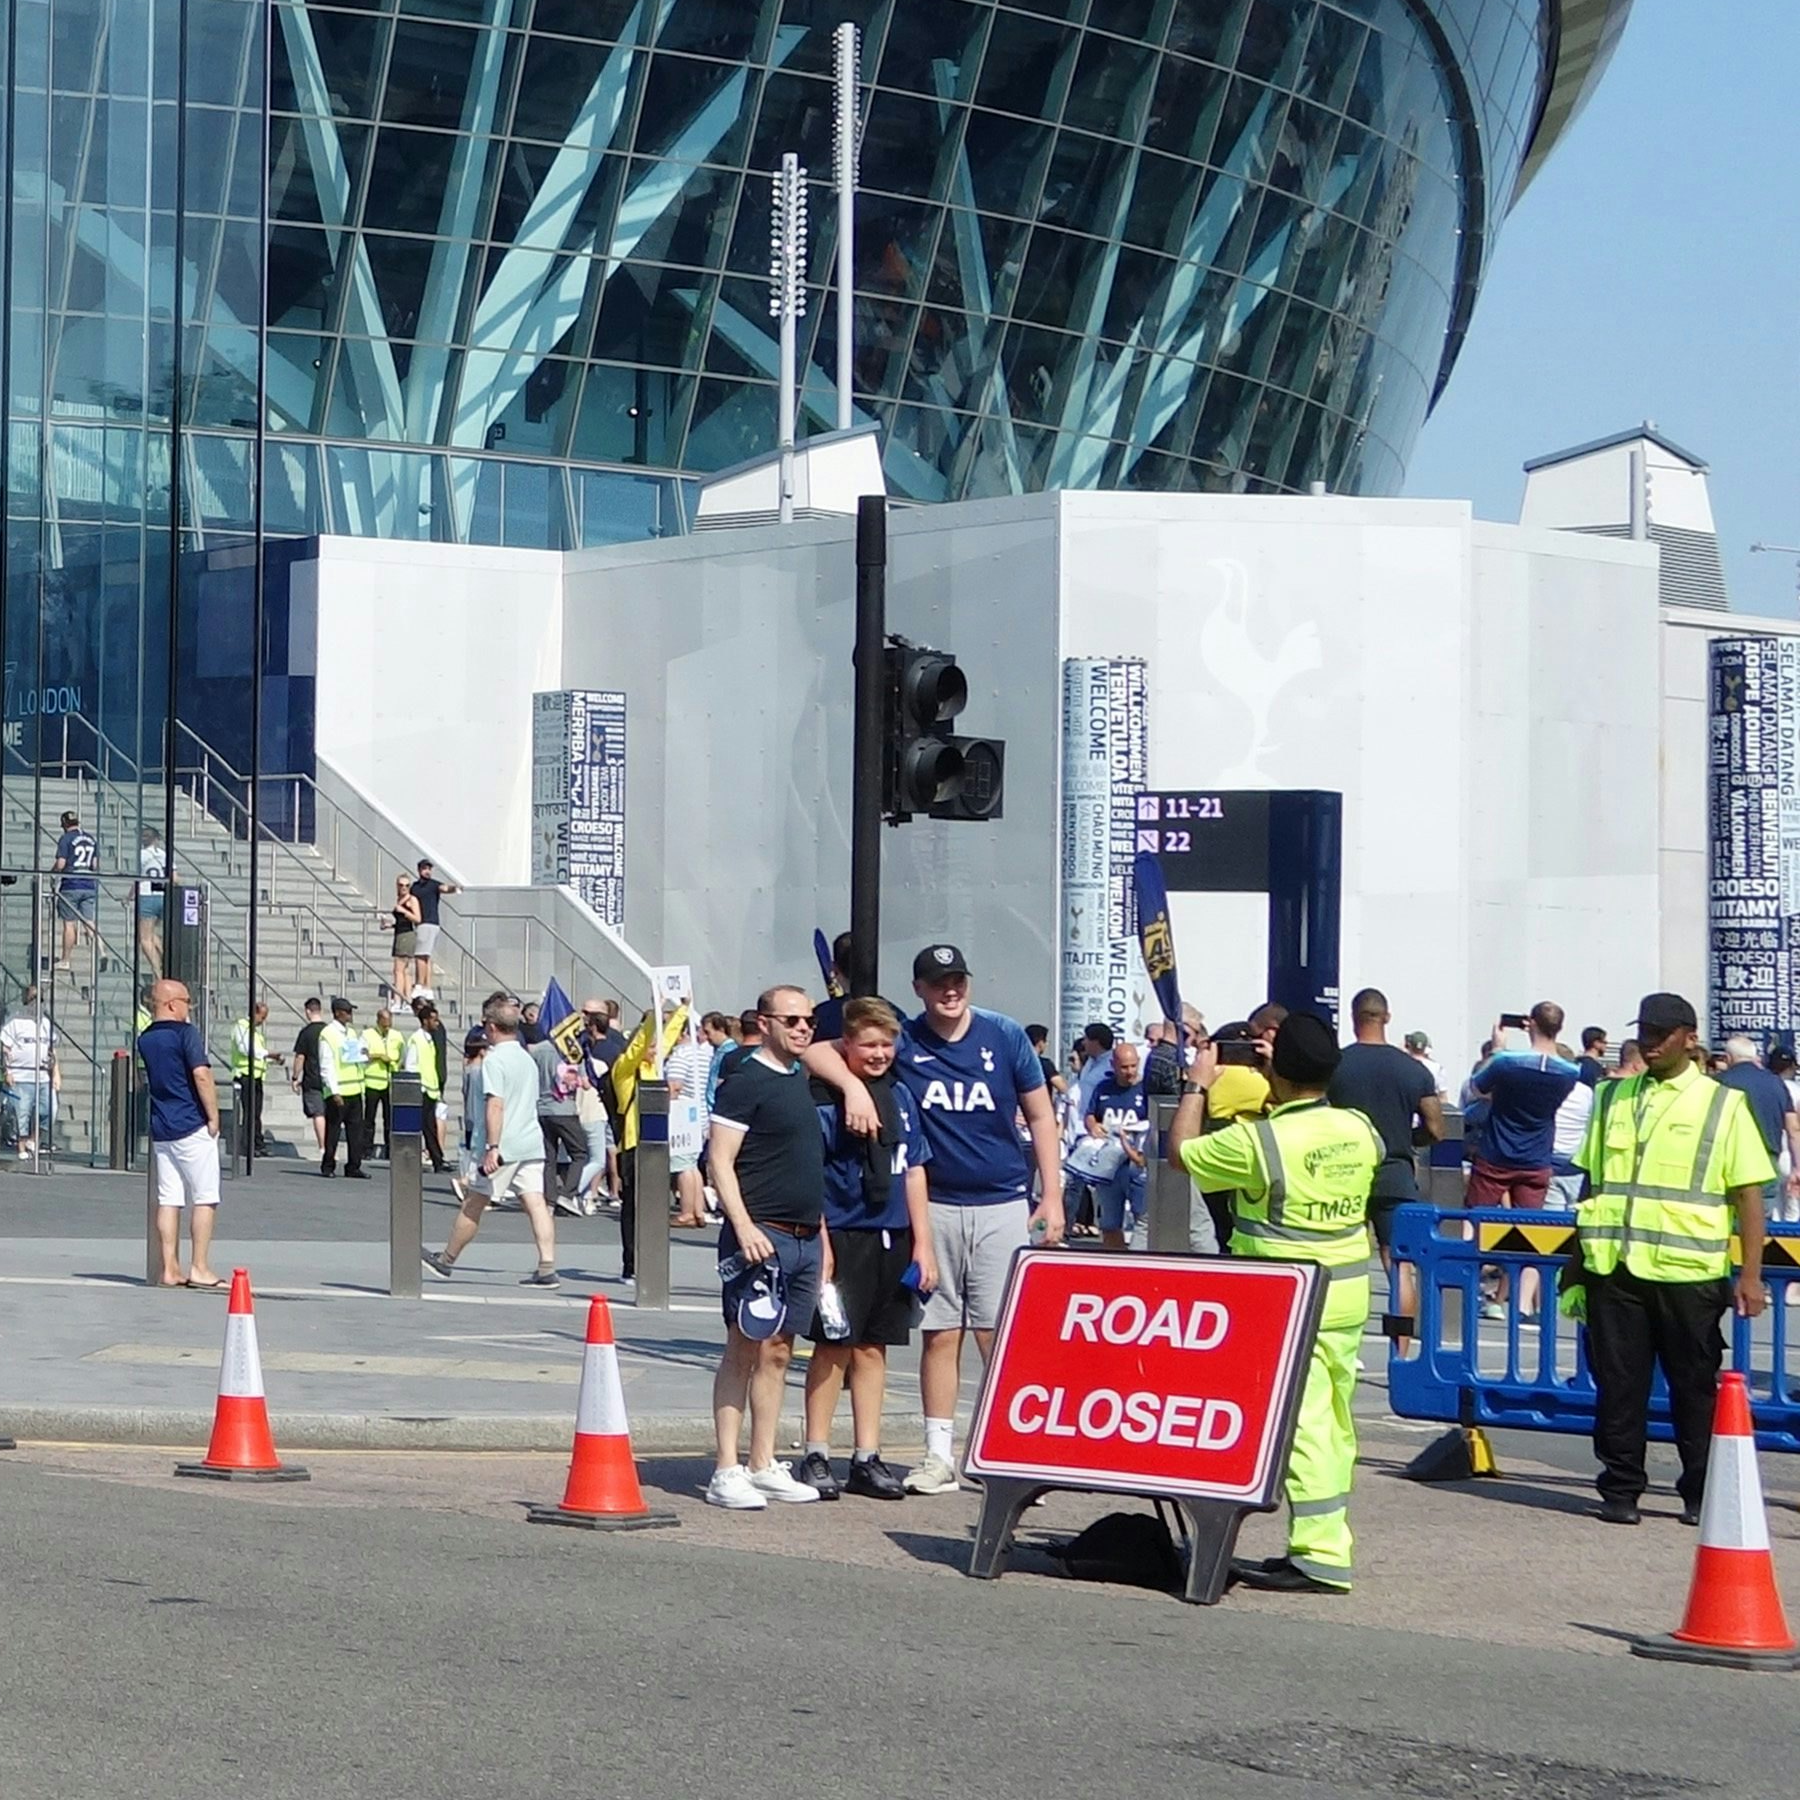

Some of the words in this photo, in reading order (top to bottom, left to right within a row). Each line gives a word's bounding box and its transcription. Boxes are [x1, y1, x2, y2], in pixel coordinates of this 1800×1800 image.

[19, 686, 81, 716] LONDON
[1742, 641, 1761, 701] ДОБРЕ
[1761, 640, 1778, 711] SELAMAT
[1780, 641, 1795, 723] SELAMAT
[571, 691, 586, 763] MERHBA
[1089, 665, 1108, 761] WELCOME
[1110, 664, 1129, 783] TERVETULOA
[1128, 664, 1143, 782] WILLKOMMEN
[1742, 704, 1761, 772] ДОШЛИ
[1761, 712, 1778, 772] DATANG
[1780, 727, 1795, 795] DATANG
[571, 821, 613, 834] CROESO
[1165, 798, 1224, 818] 11-21
[1761, 788, 1779, 878] BENVENUTI
[73, 845, 95, 868] 27
[556, 822, 568, 885] WELC
[614, 822, 624, 877] WELCOME
[1165, 832, 1191, 851] 22
[1109, 875, 1124, 938] WELKOM
[1711, 878, 1779, 897] CROESO
[1711, 900, 1779, 918] WITAMY
[1720, 951, 1775, 965] CROESO
[1777, 951, 1789, 1030] BIENVENIDOS
[921, 1080, 996, 1112] AIA
[1102, 1107, 1139, 1126] AIA
[1060, 1293, 1230, 1351] ROAD
[1008, 1384, 1243, 1451] CLOSED
